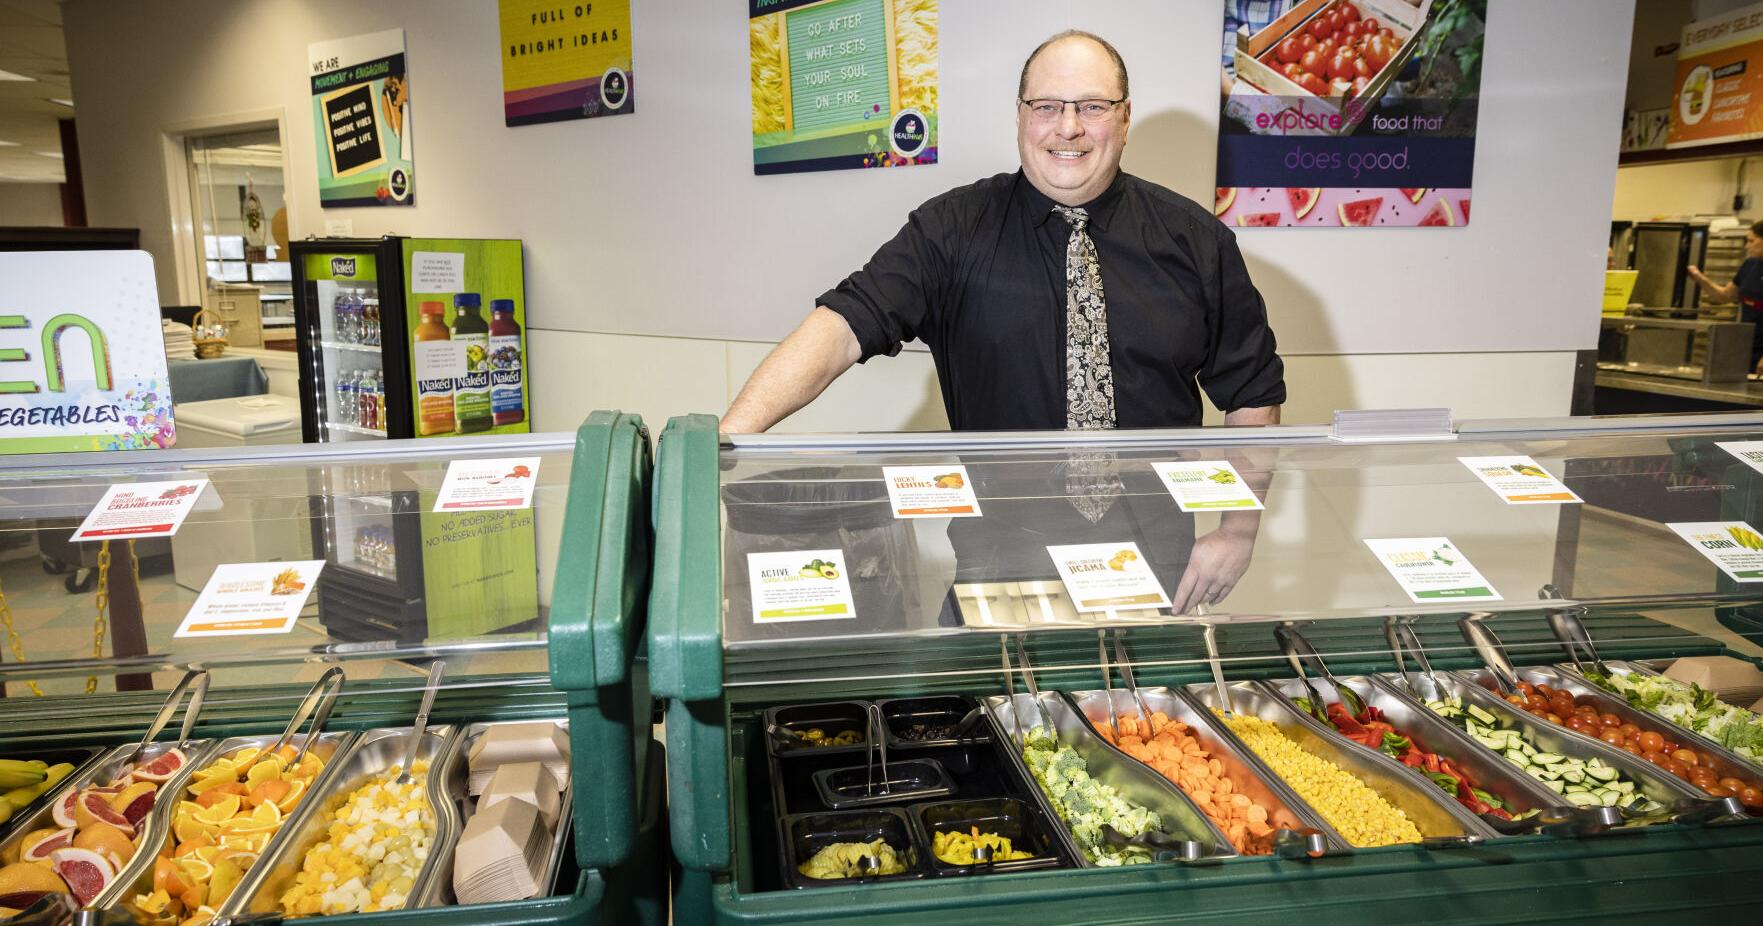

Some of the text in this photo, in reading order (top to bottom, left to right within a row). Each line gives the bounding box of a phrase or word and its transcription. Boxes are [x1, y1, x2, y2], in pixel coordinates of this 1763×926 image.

[532, 4, 592, 24] FULL OF
[808, 13, 862, 36] GO AFTER
[511, 29, 618, 57] BRIGHT IDEAS
[806, 38, 866, 60] WHAT SETS
[313, 57, 339, 72] WE ARE
[315, 72, 347, 88] MOVEMENT
[355, 62, 389, 79] ENGAGING
[804, 65, 868, 86] YOUR SOUL
[816, 90, 861, 108] ON FIRE
[331, 108, 352, 122] POSITIVE
[1256, 99, 1443, 136] explore food that
[334, 116, 372, 137] POSITIVE VIBES
[336, 132, 372, 152] POSITIVE LIFE
[1284, 147, 1411, 178] does good.
[108, 498, 182, 510] CRANBERRIES
[441, 510, 517, 532] NO ADDED SUGAR
[426, 537, 440, 547] NO
[511, 517, 532, 528] EVER
[1700, 540, 1738, 550] CORN
[761, 568, 789, 578] ACTIVE
